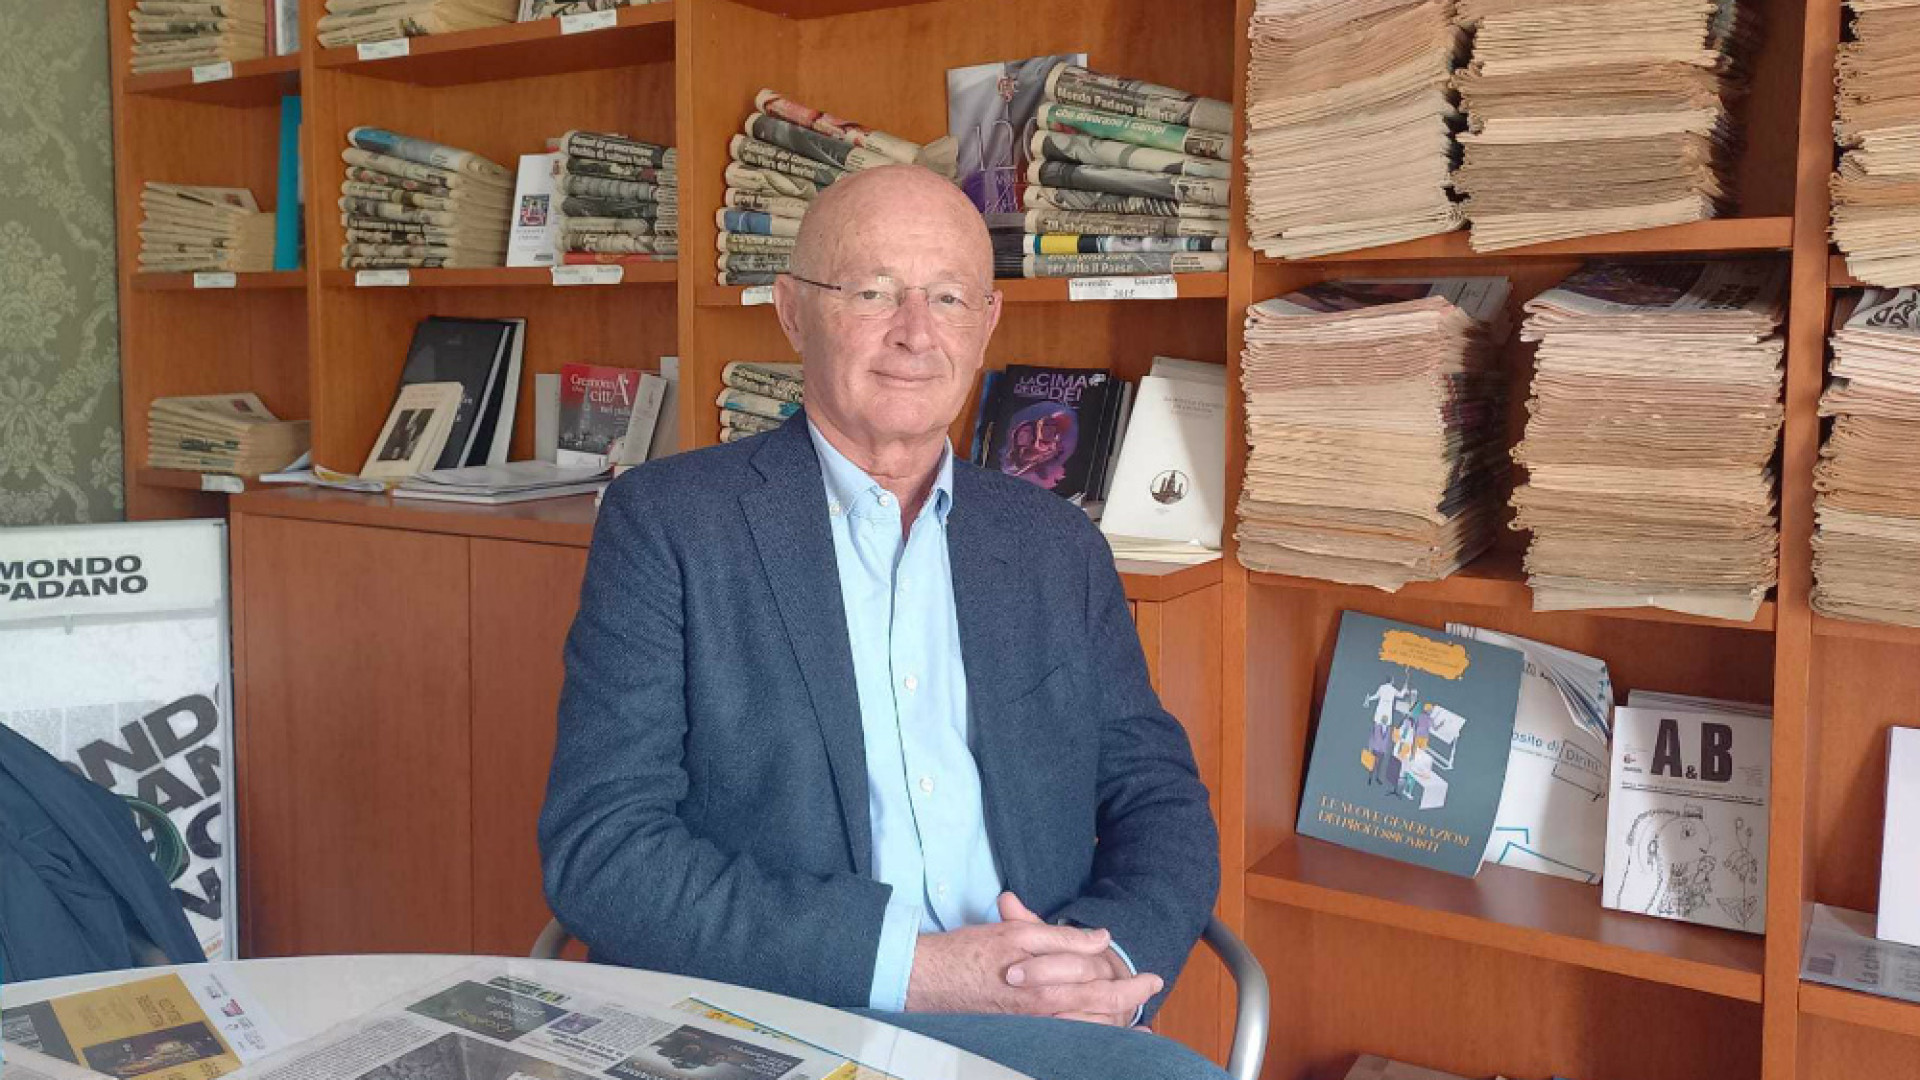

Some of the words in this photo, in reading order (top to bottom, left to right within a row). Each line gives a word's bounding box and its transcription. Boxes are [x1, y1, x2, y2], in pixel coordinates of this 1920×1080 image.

[1036, 373, 1089, 389] CIMA
[1048, 387, 1082, 401] DEI
[0, 555, 142, 580] MONDO
